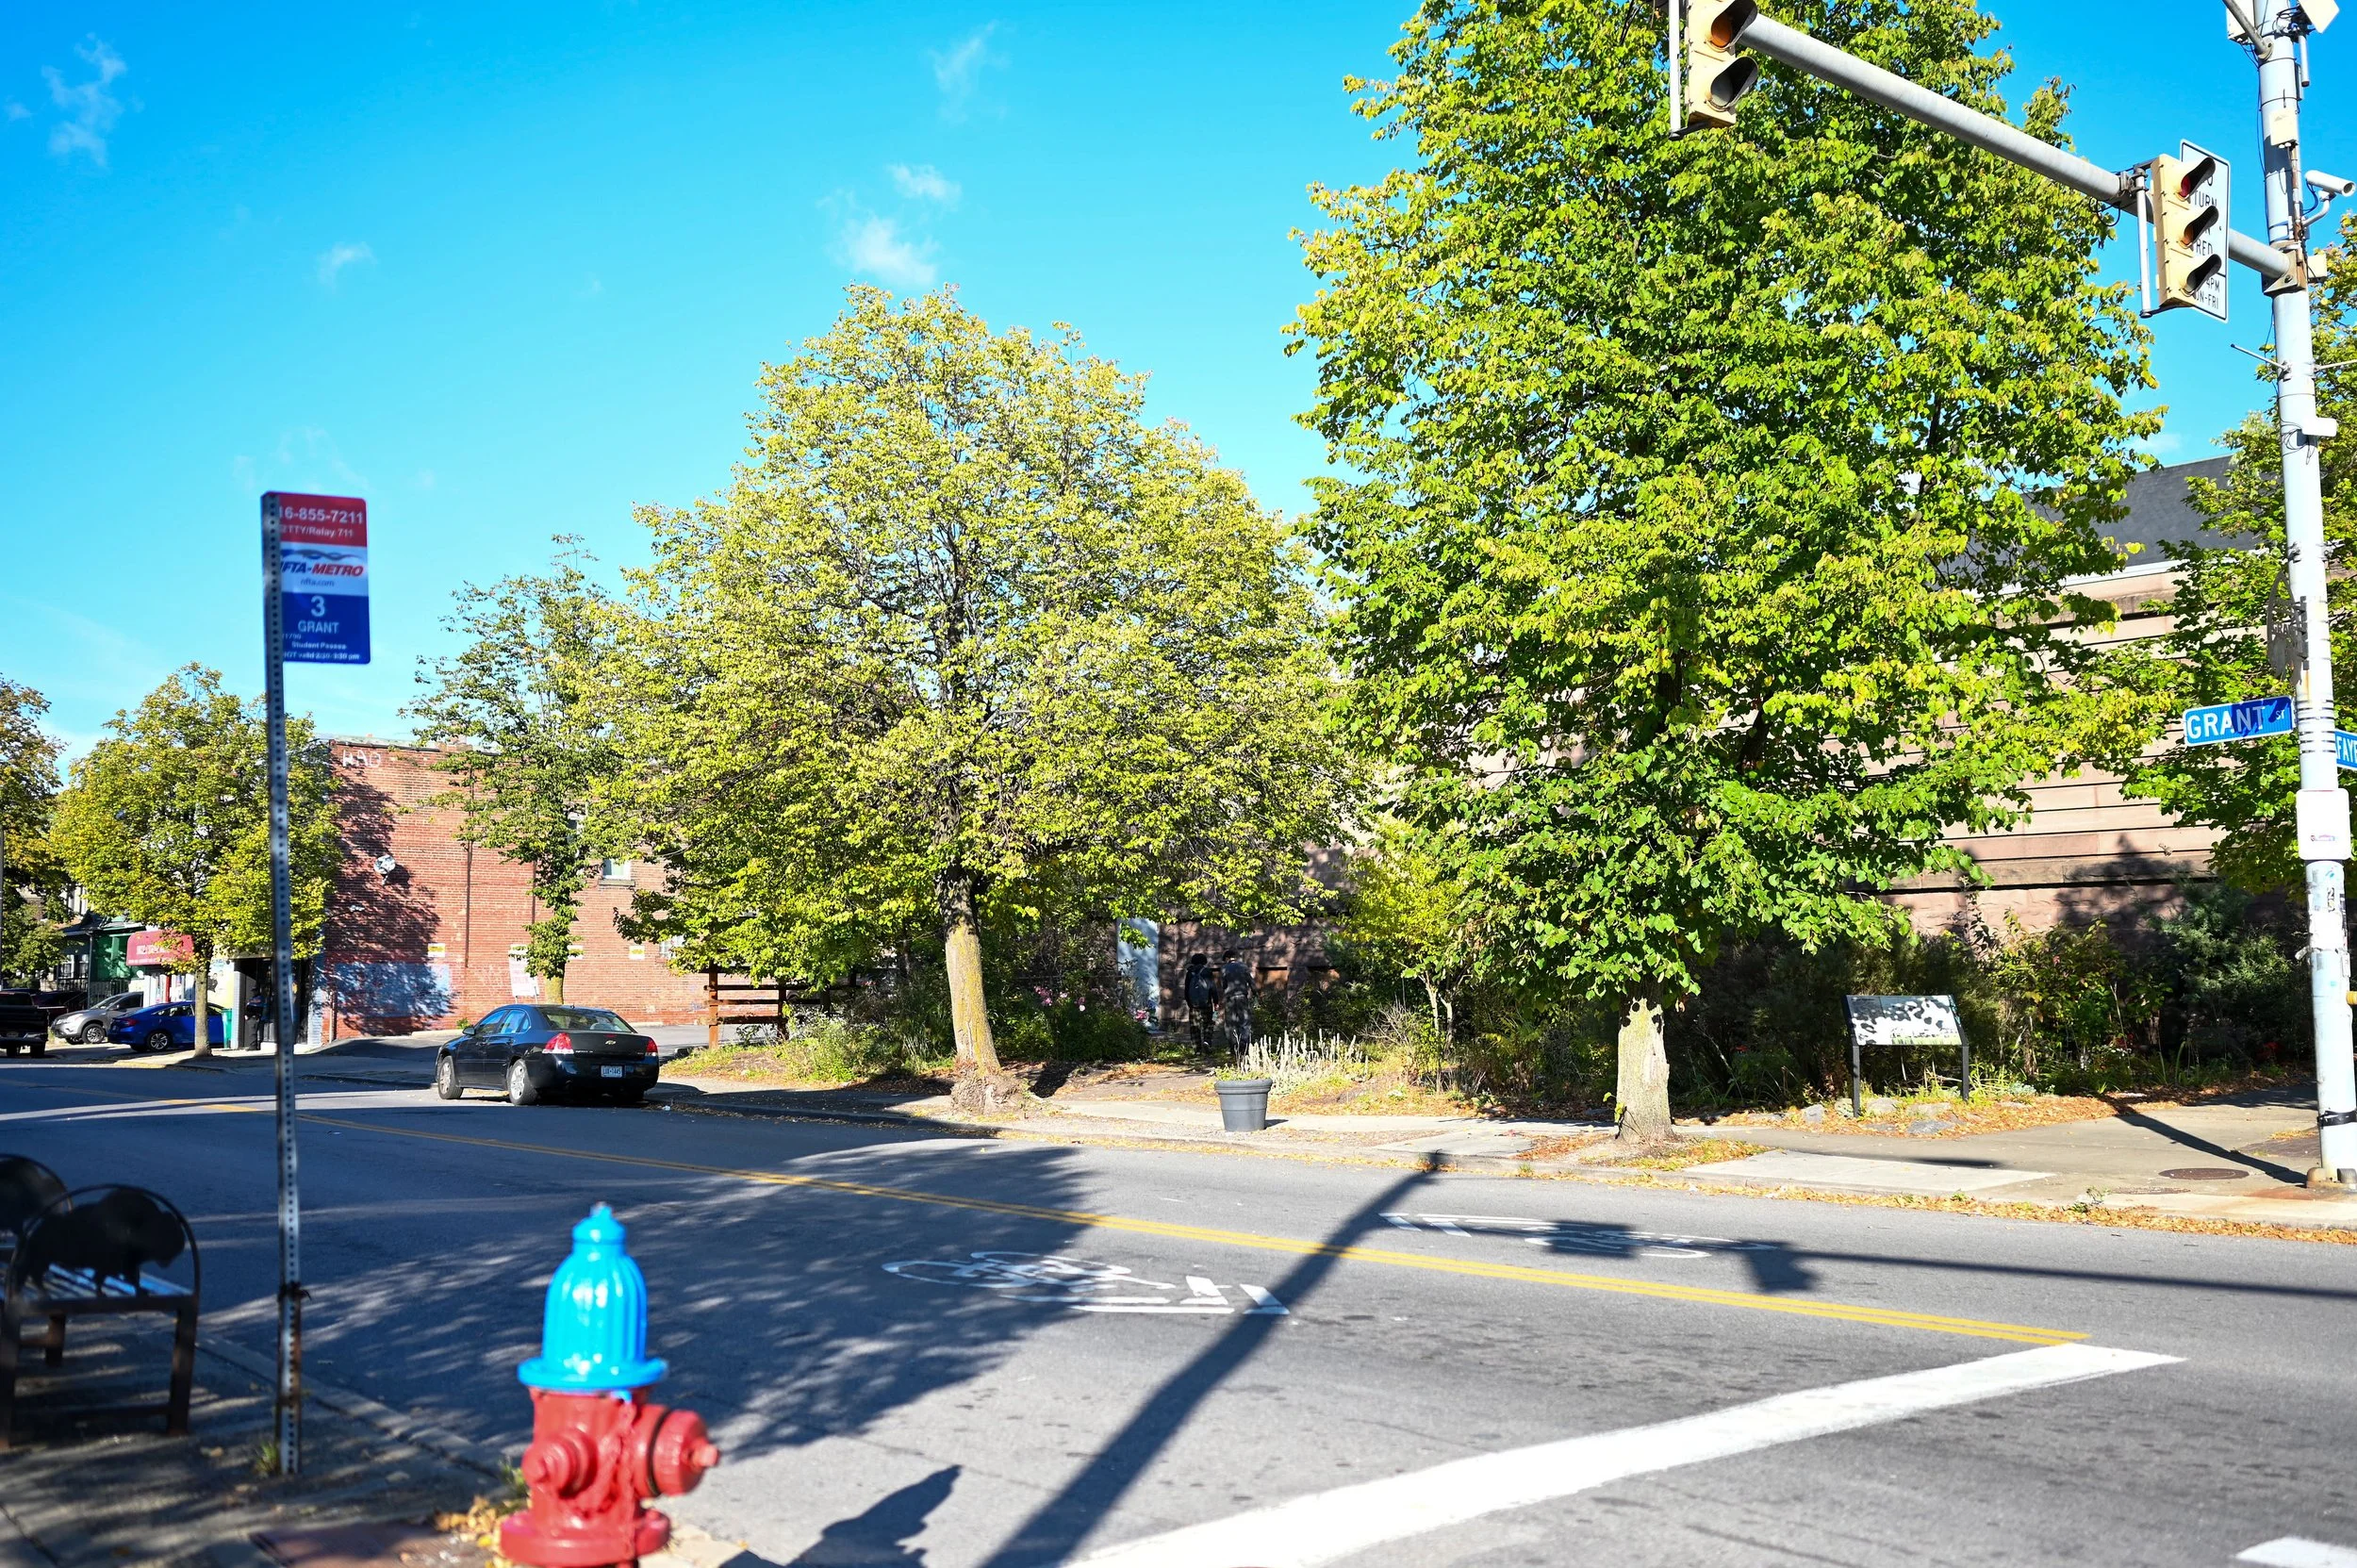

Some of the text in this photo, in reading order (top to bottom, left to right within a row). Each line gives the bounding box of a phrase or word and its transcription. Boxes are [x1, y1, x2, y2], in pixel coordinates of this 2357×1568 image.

[2194, 190, 2217, 207] TURN
[338, 527, 354, 537] 711
[310, 595, 326, 618] 3
[298, 620, 339, 634] GRANT
[291, 640, 320, 650] Student
[2186, 705, 2285, 739] GRANT ST
